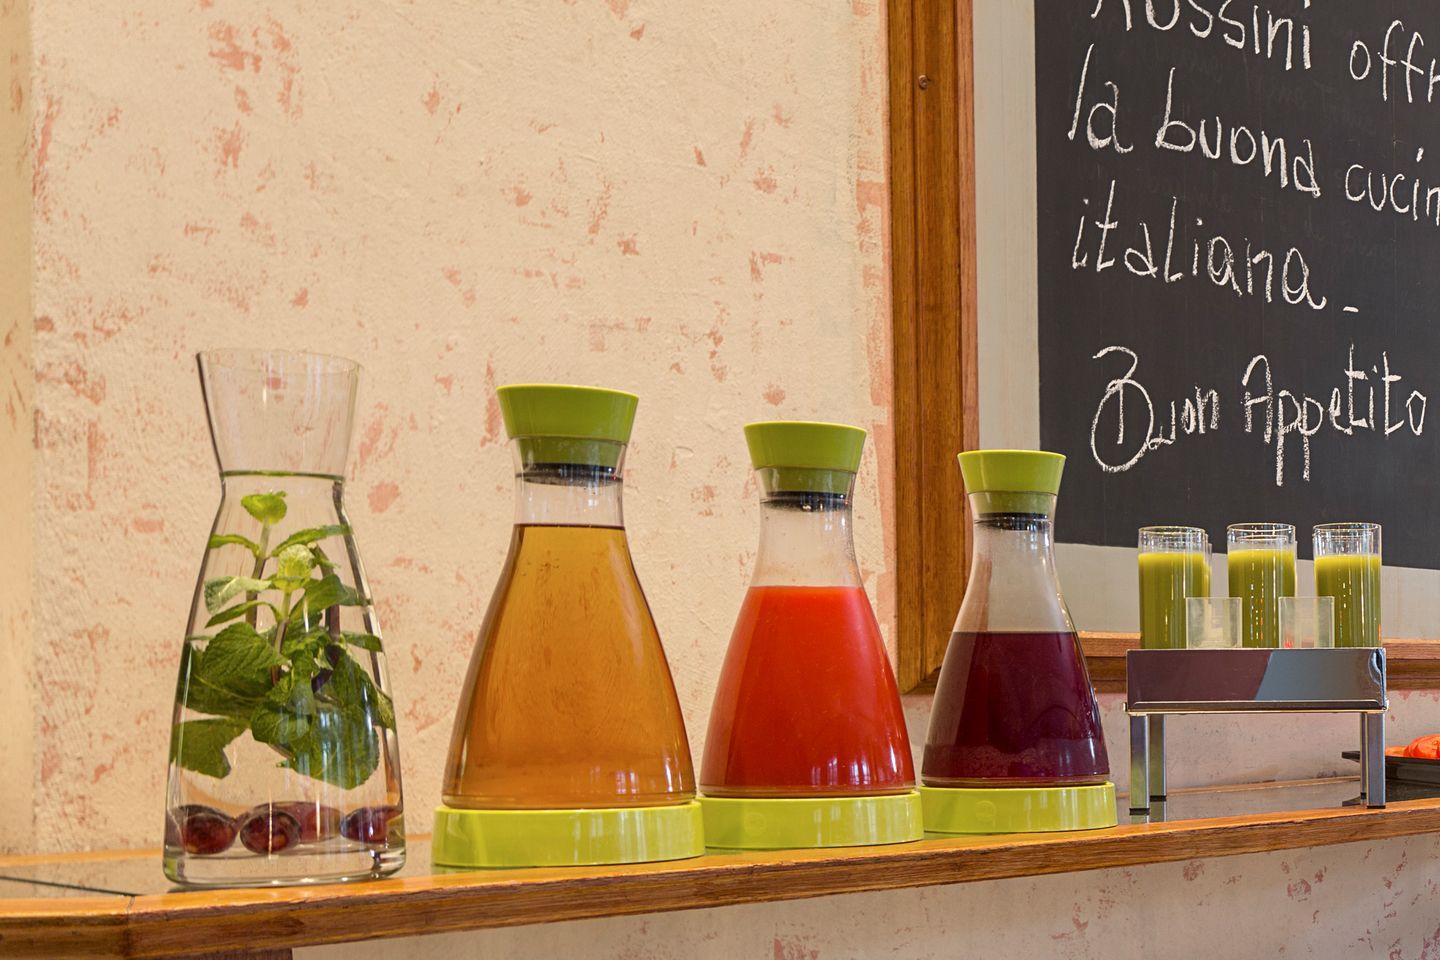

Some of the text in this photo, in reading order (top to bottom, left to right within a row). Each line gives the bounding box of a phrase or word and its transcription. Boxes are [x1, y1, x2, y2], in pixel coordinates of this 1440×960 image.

[1090, 0, 1311, 70] ossini
[1068, 43, 1134, 153] la
[1155, 67, 1321, 198] buona
[1090, 346, 1220, 473] Buon
